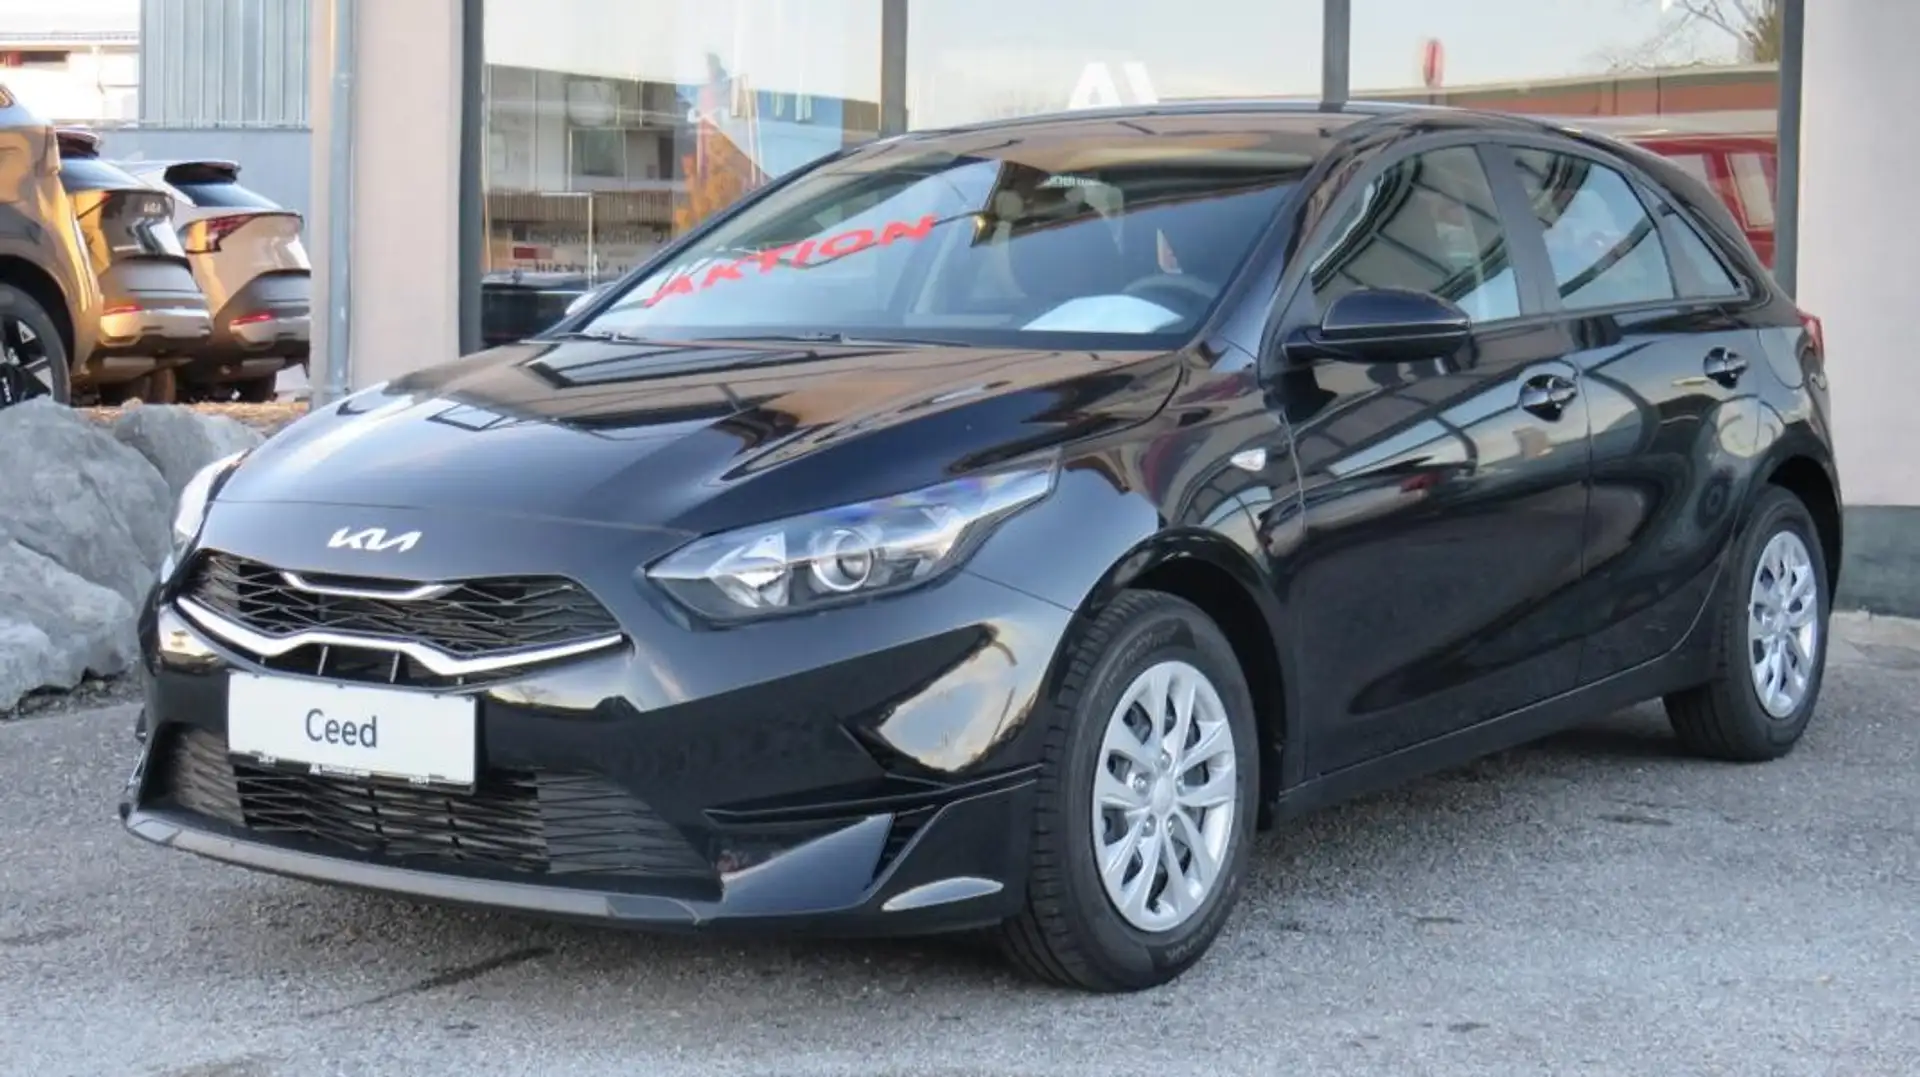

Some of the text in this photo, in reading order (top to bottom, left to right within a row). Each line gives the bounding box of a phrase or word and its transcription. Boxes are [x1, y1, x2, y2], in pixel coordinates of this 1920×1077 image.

[643, 213, 938, 308] AKTION
[327, 526, 423, 553] KIA
[305, 707, 377, 748] Ceed
